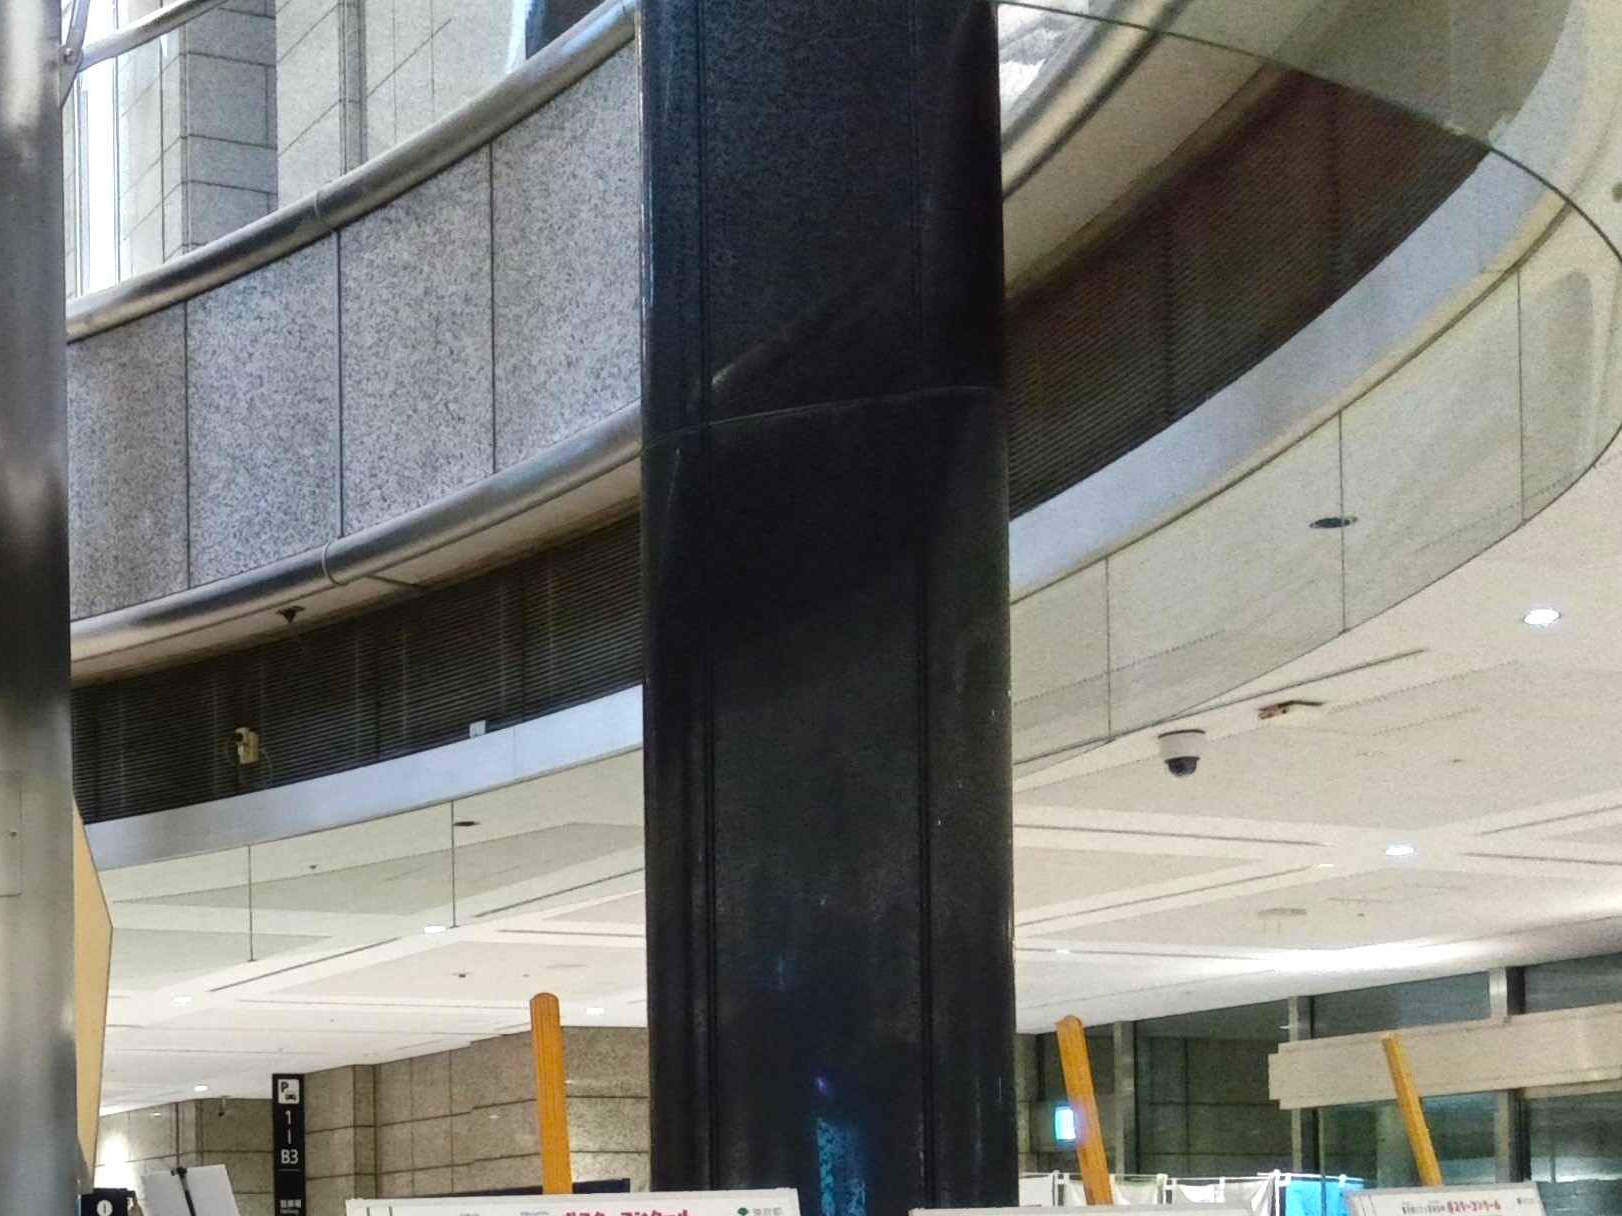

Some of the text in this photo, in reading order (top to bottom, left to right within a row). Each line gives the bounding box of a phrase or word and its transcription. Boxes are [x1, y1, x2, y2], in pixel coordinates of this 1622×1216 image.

[281, 1082, 289, 1093] P
[285, 1110, 292, 1125] 1
[281, 1149, 299, 1164] B3
